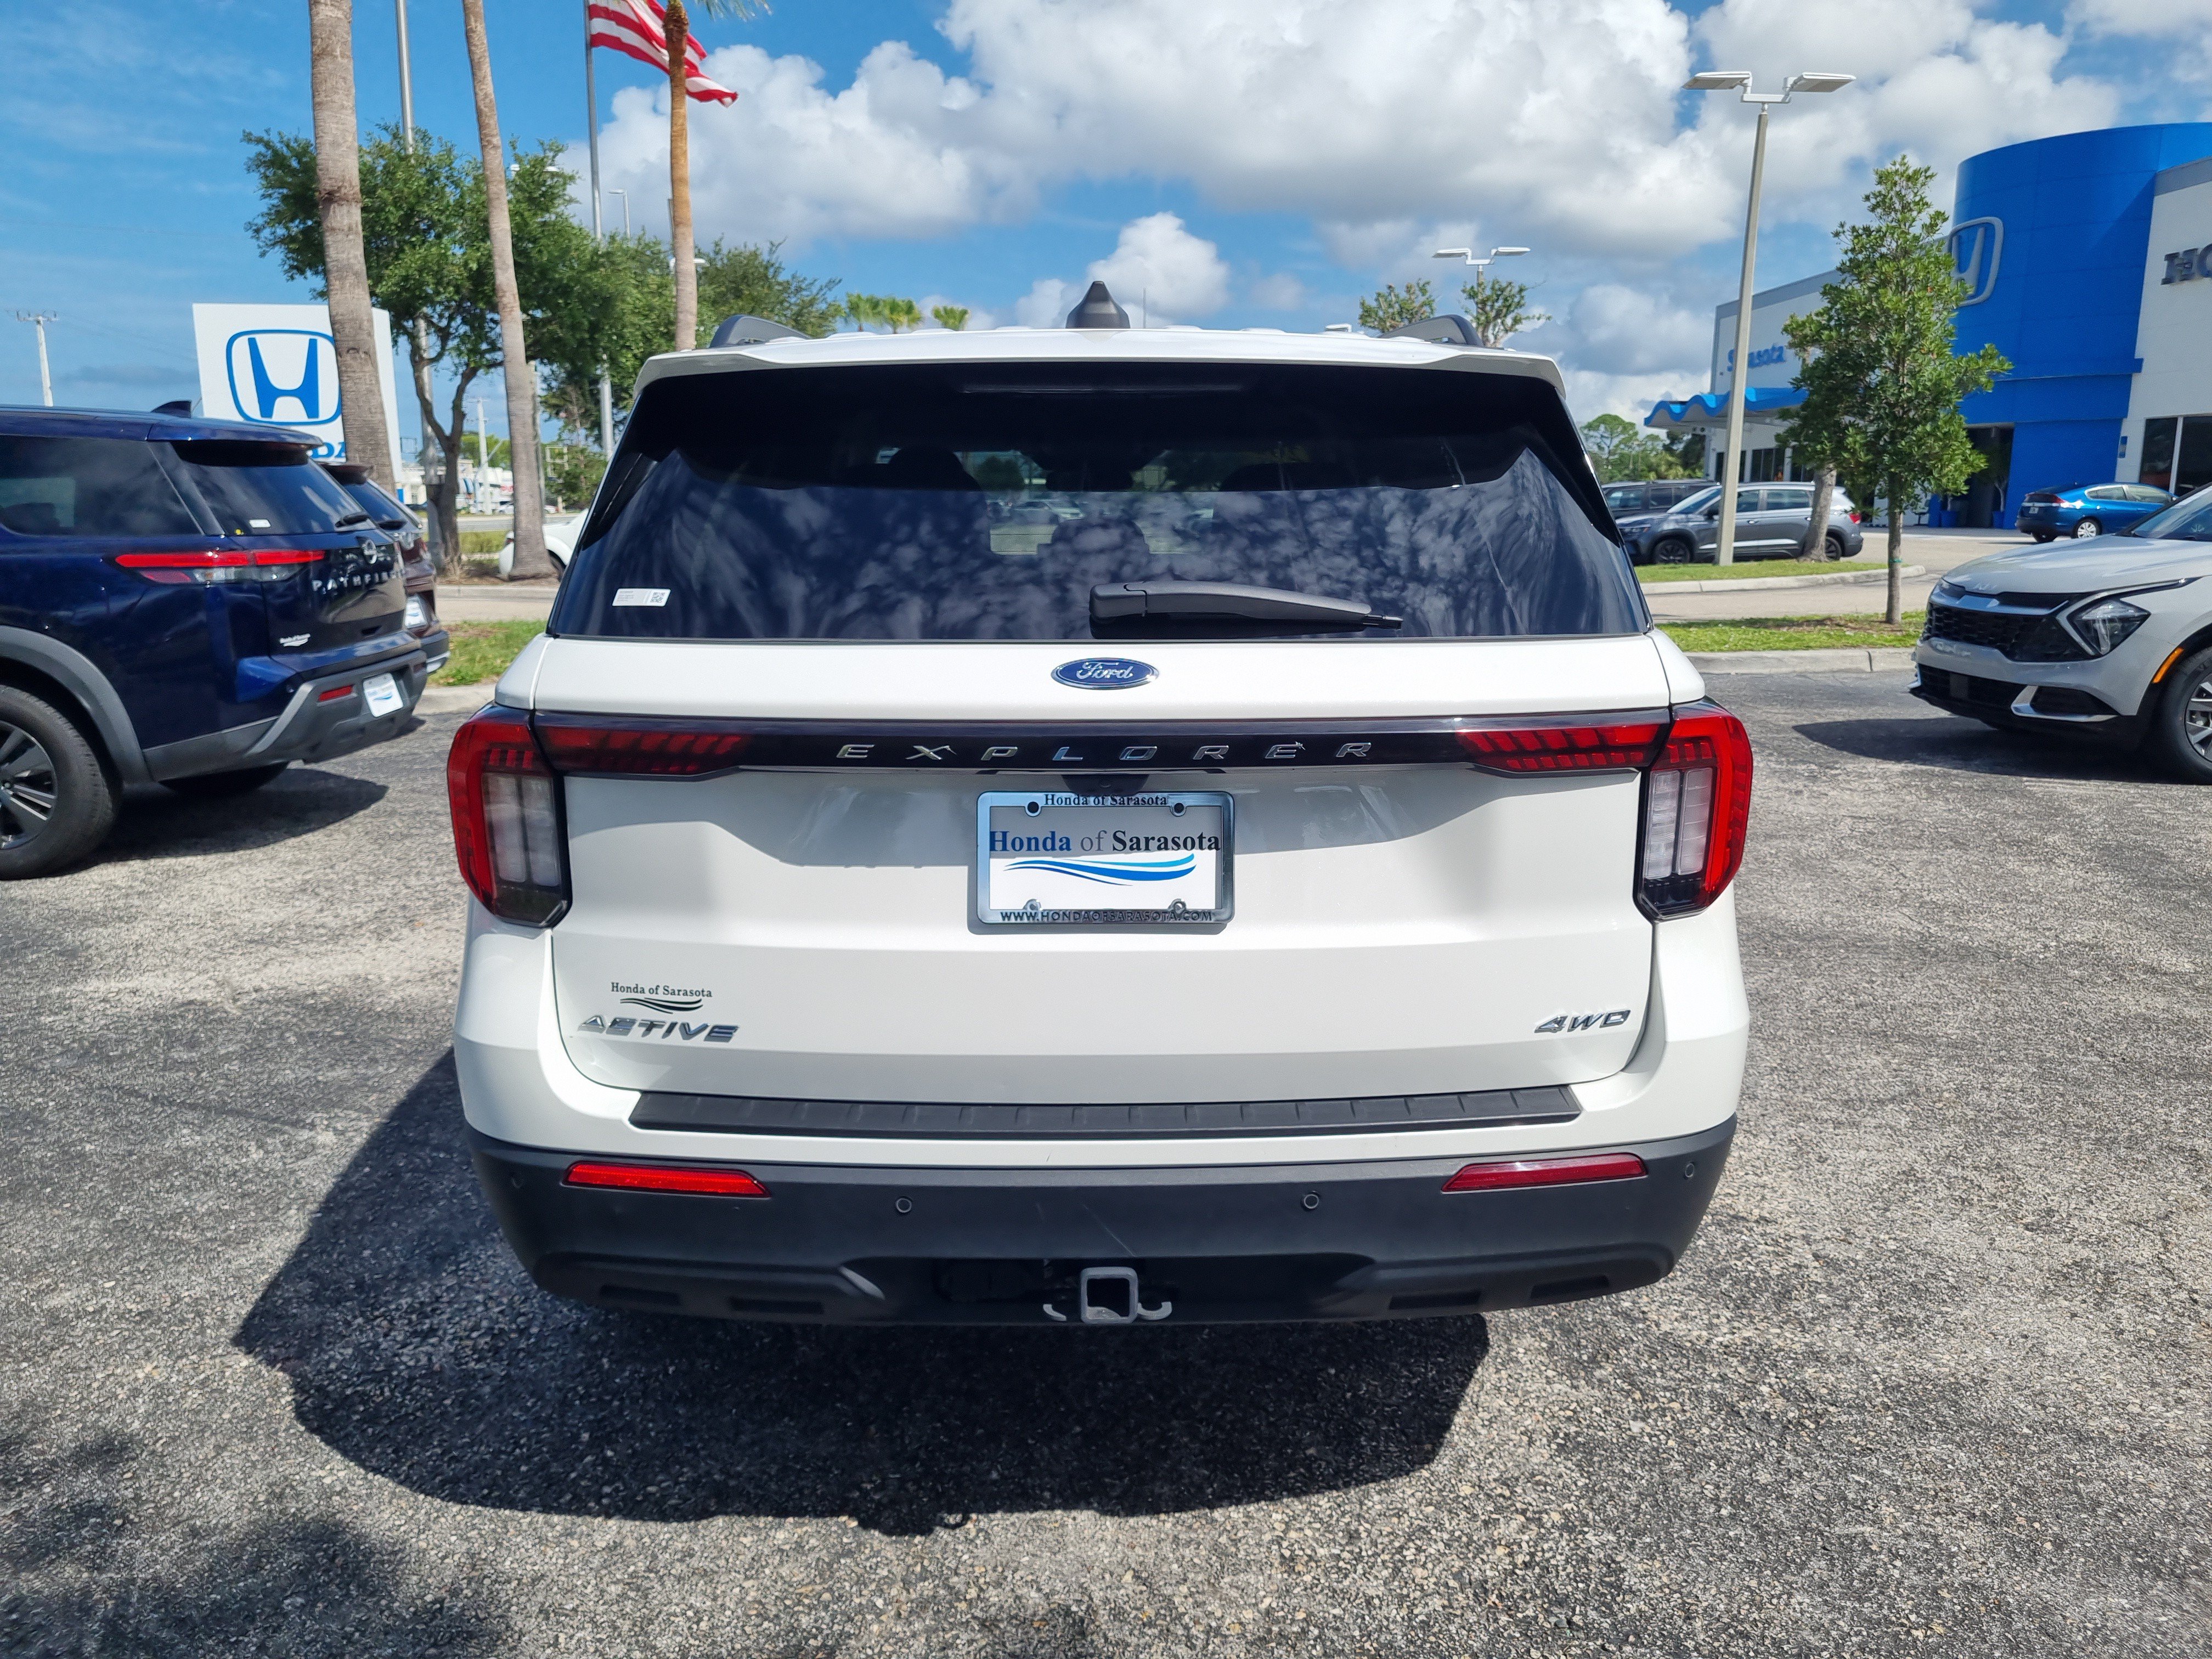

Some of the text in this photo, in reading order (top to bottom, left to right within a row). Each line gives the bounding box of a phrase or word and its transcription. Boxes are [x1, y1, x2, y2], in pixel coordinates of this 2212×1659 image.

[1726, 343, 1786, 372] Sasota
[1076, 662, 1134, 680] Ford
[836, 742, 1373, 761] EXPLORER
[1044, 794, 1167, 805] Honda of Sarasota
[990, 830, 1221, 852] Honda of Sarasota
[1001, 910, 1212, 922] WWW.HONDAOFSARASOTA.COM
[611, 982, 713, 997] Honda of Sarasota
[577, 1015, 741, 1042] ACTIVE
[1534, 1009, 1632, 1033] 4WD
